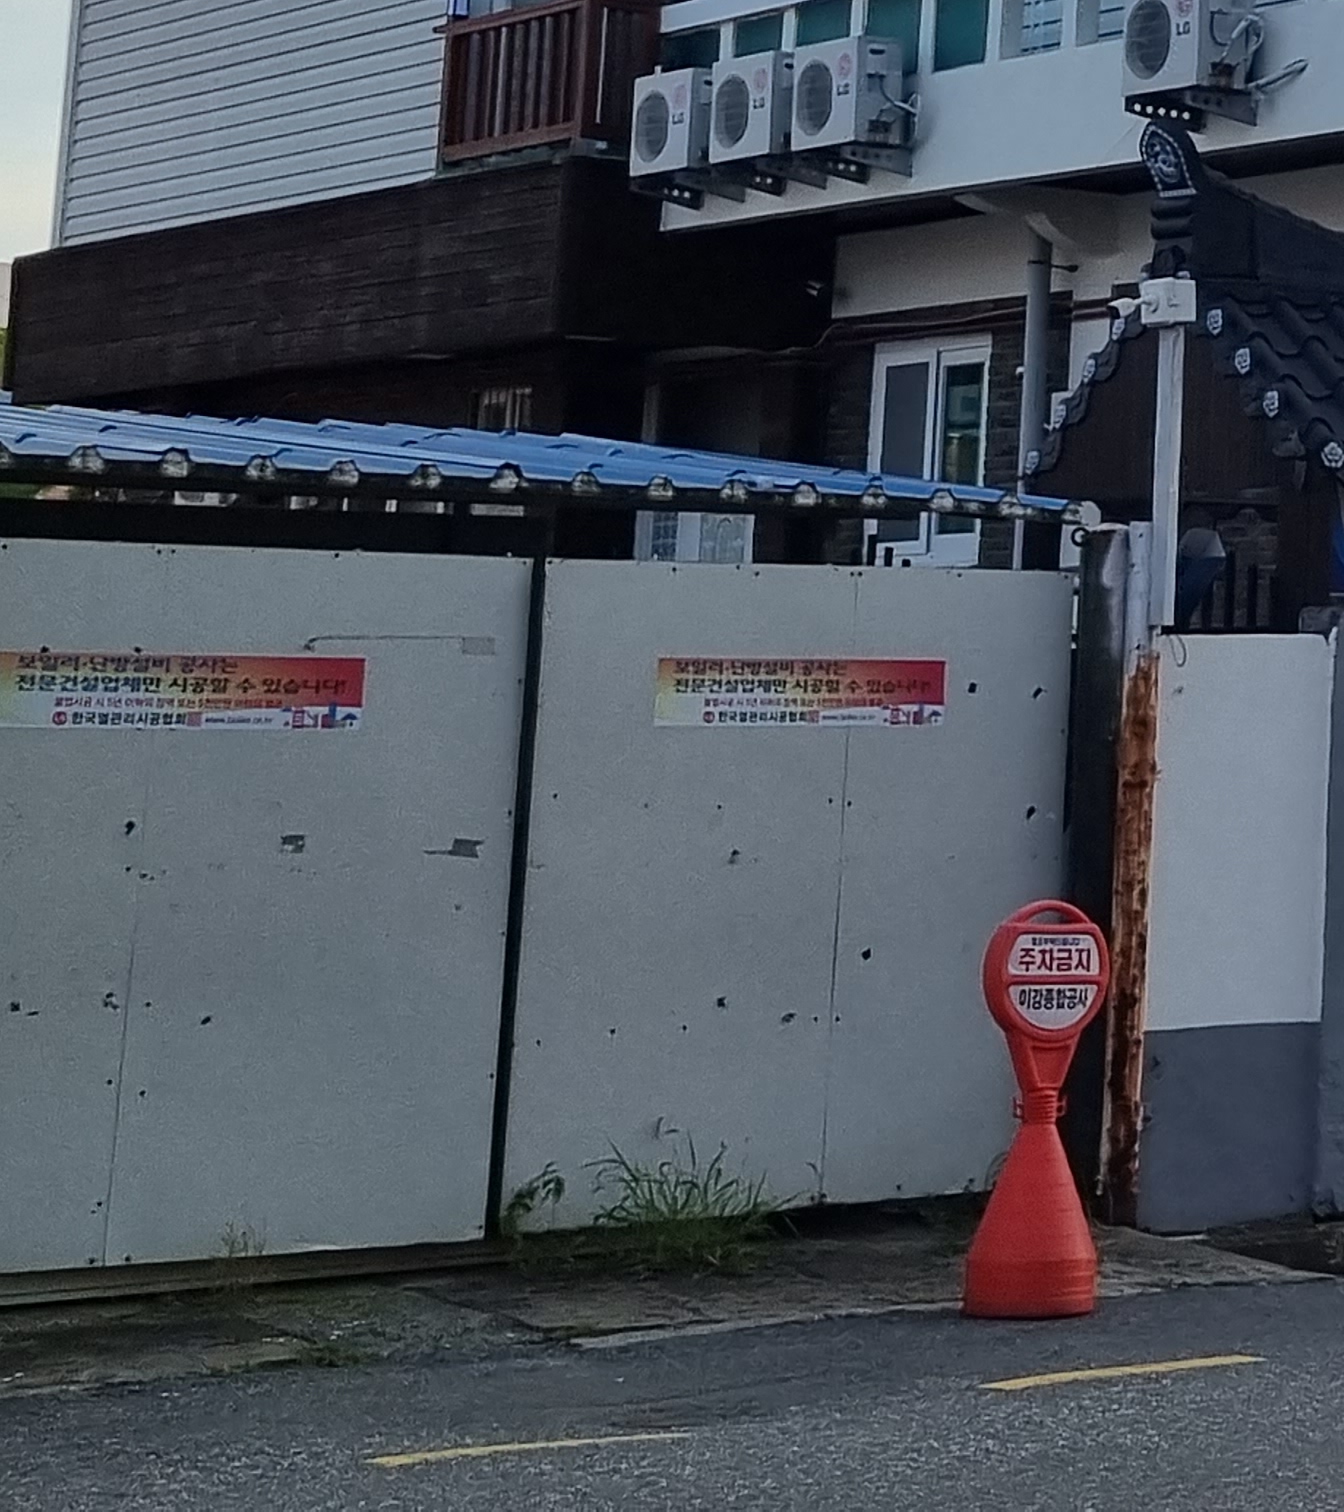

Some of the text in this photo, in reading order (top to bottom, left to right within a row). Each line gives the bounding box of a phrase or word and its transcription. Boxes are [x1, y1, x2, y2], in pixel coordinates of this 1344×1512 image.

[1175, 22, 1191, 37] LG
[836, 81, 850, 97] LG
[752, 95, 766, 110] LG
[671, 111, 685, 125] LG
[236, 676, 258, 693] 수
[1018, 947, 1092, 973] 주차금지
[1018, 987, 1089, 1011] 이강종합공사
